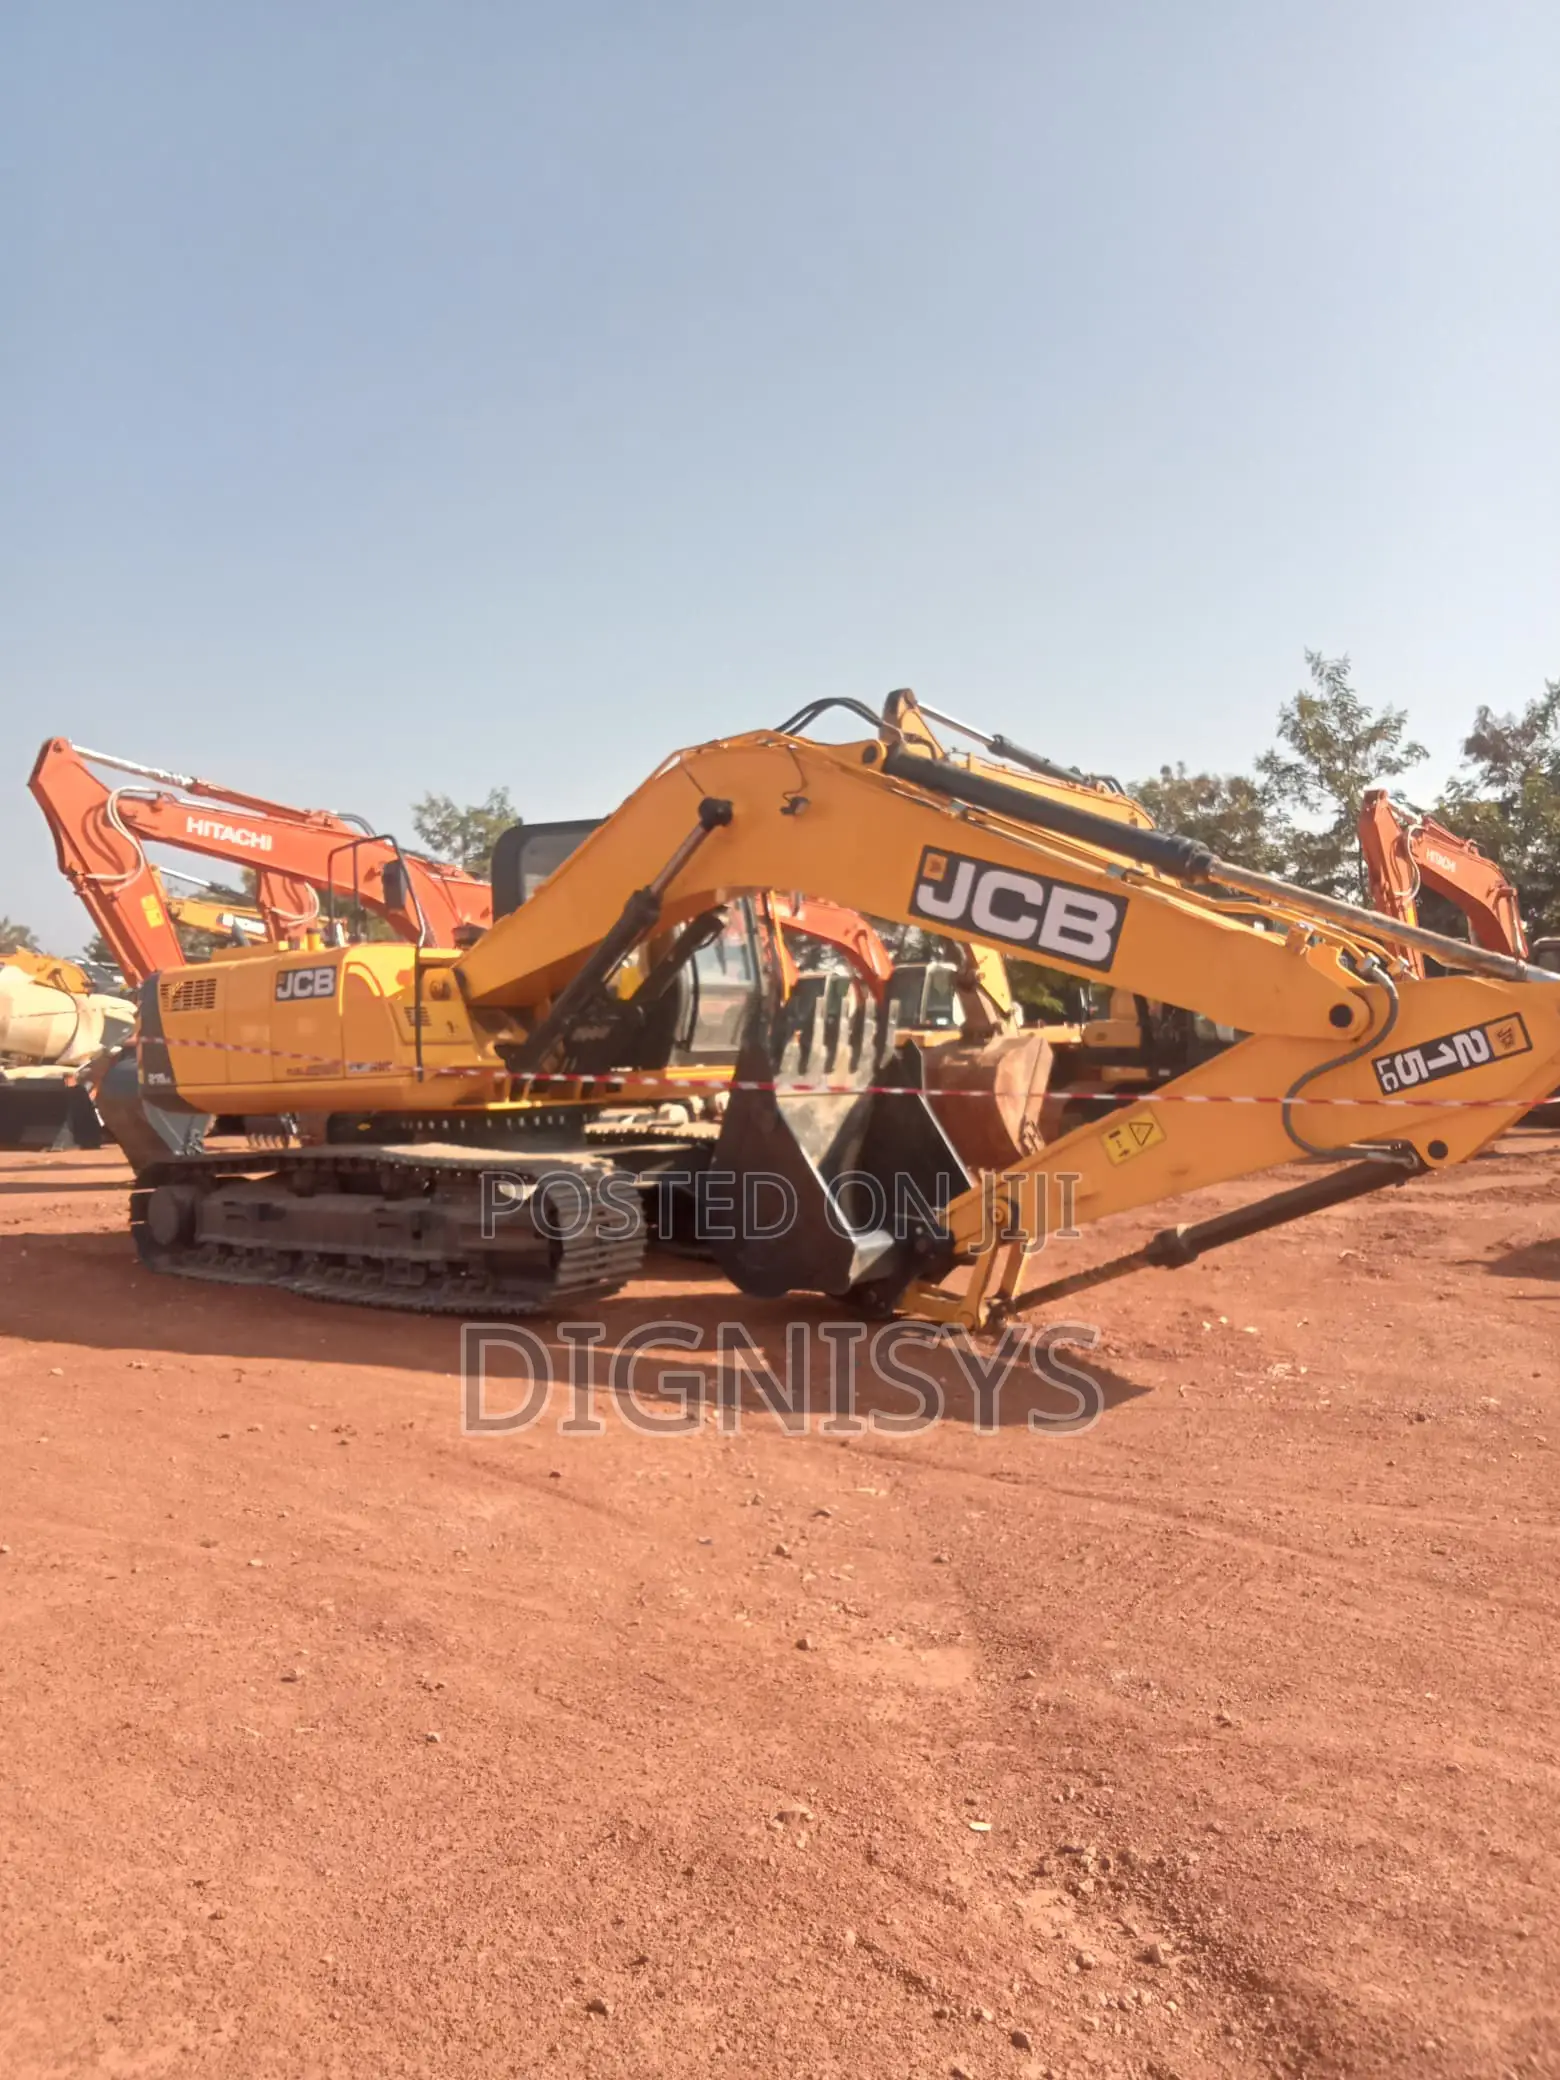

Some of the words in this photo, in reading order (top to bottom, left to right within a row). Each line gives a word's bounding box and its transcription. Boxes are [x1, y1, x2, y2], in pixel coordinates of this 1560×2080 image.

[186, 816, 273, 852] HITACHI
[916, 861, 1118, 962] JCB
[277, 967, 335, 999] JCB
[1394, 1029, 1490, 1086] 215
